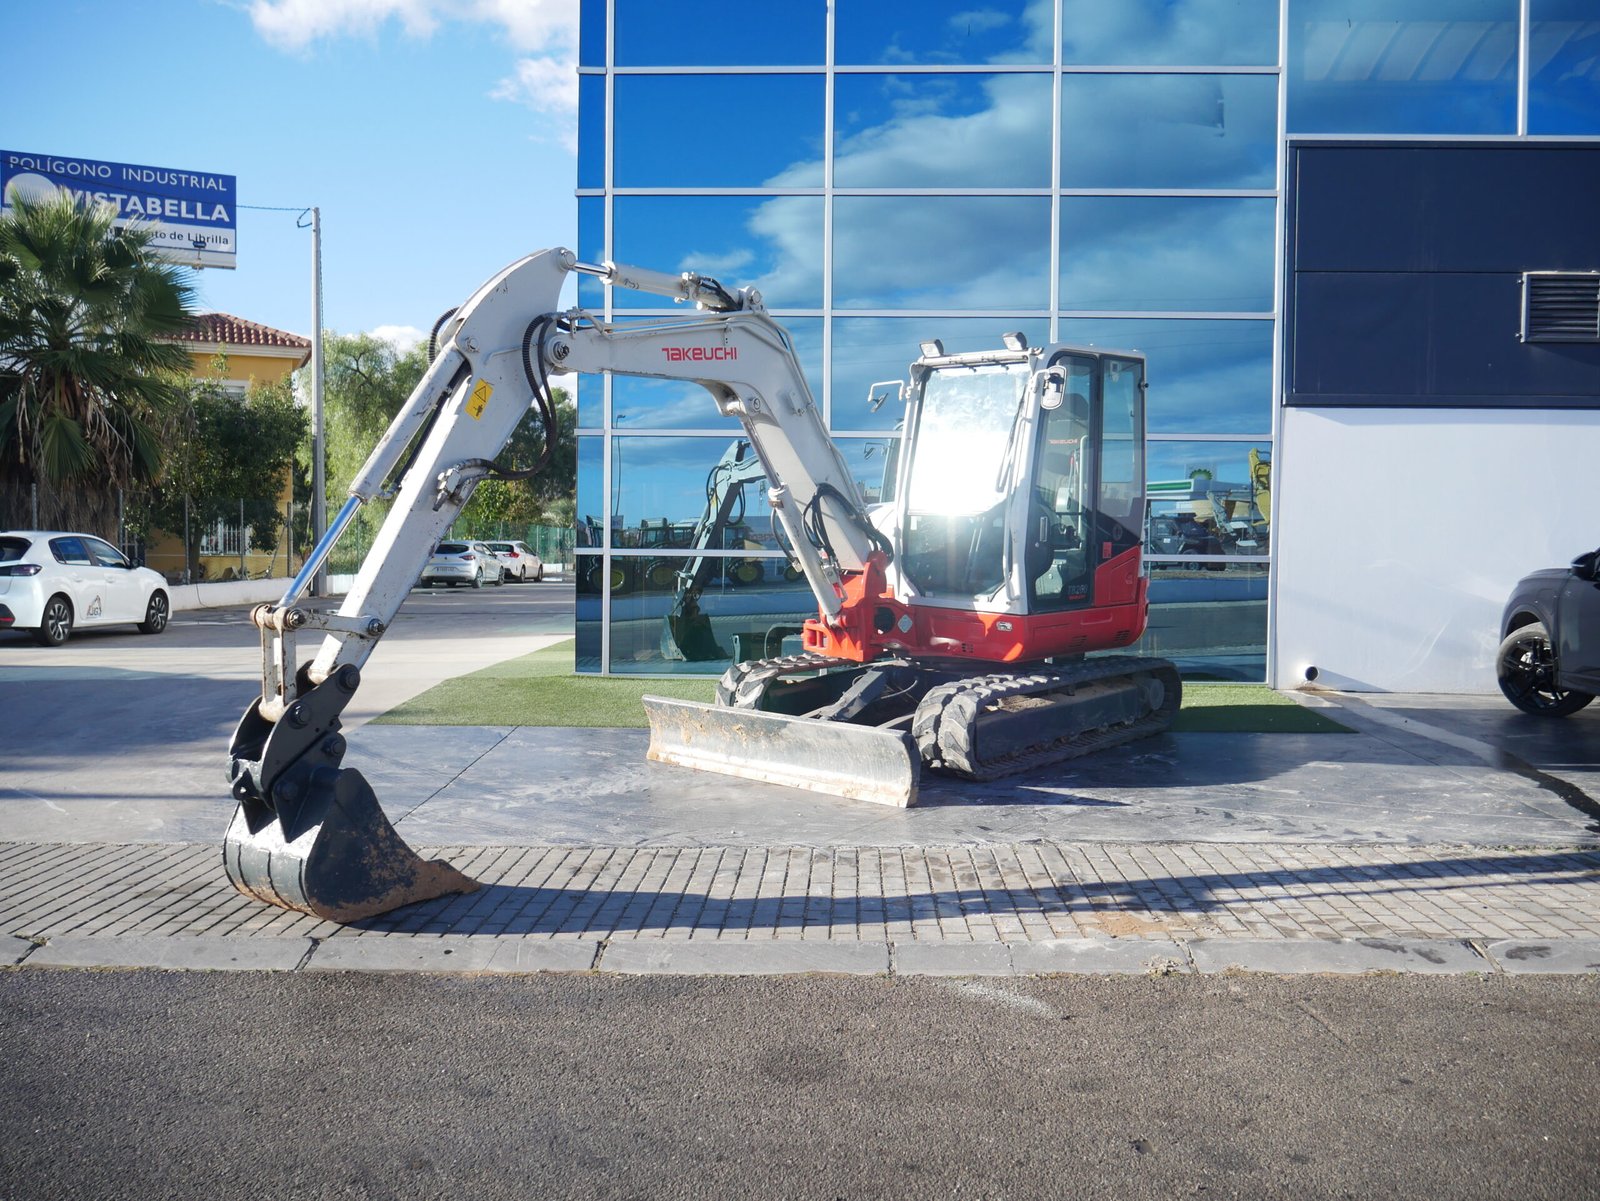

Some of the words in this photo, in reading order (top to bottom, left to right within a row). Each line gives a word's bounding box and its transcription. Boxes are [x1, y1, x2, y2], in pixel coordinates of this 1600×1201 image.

[10, 156, 112, 178] POLÍGONO
[122, 167, 228, 192] INDUSTRIAL
[169, 231, 184, 241] de
[187, 232, 229, 245] Librilla
